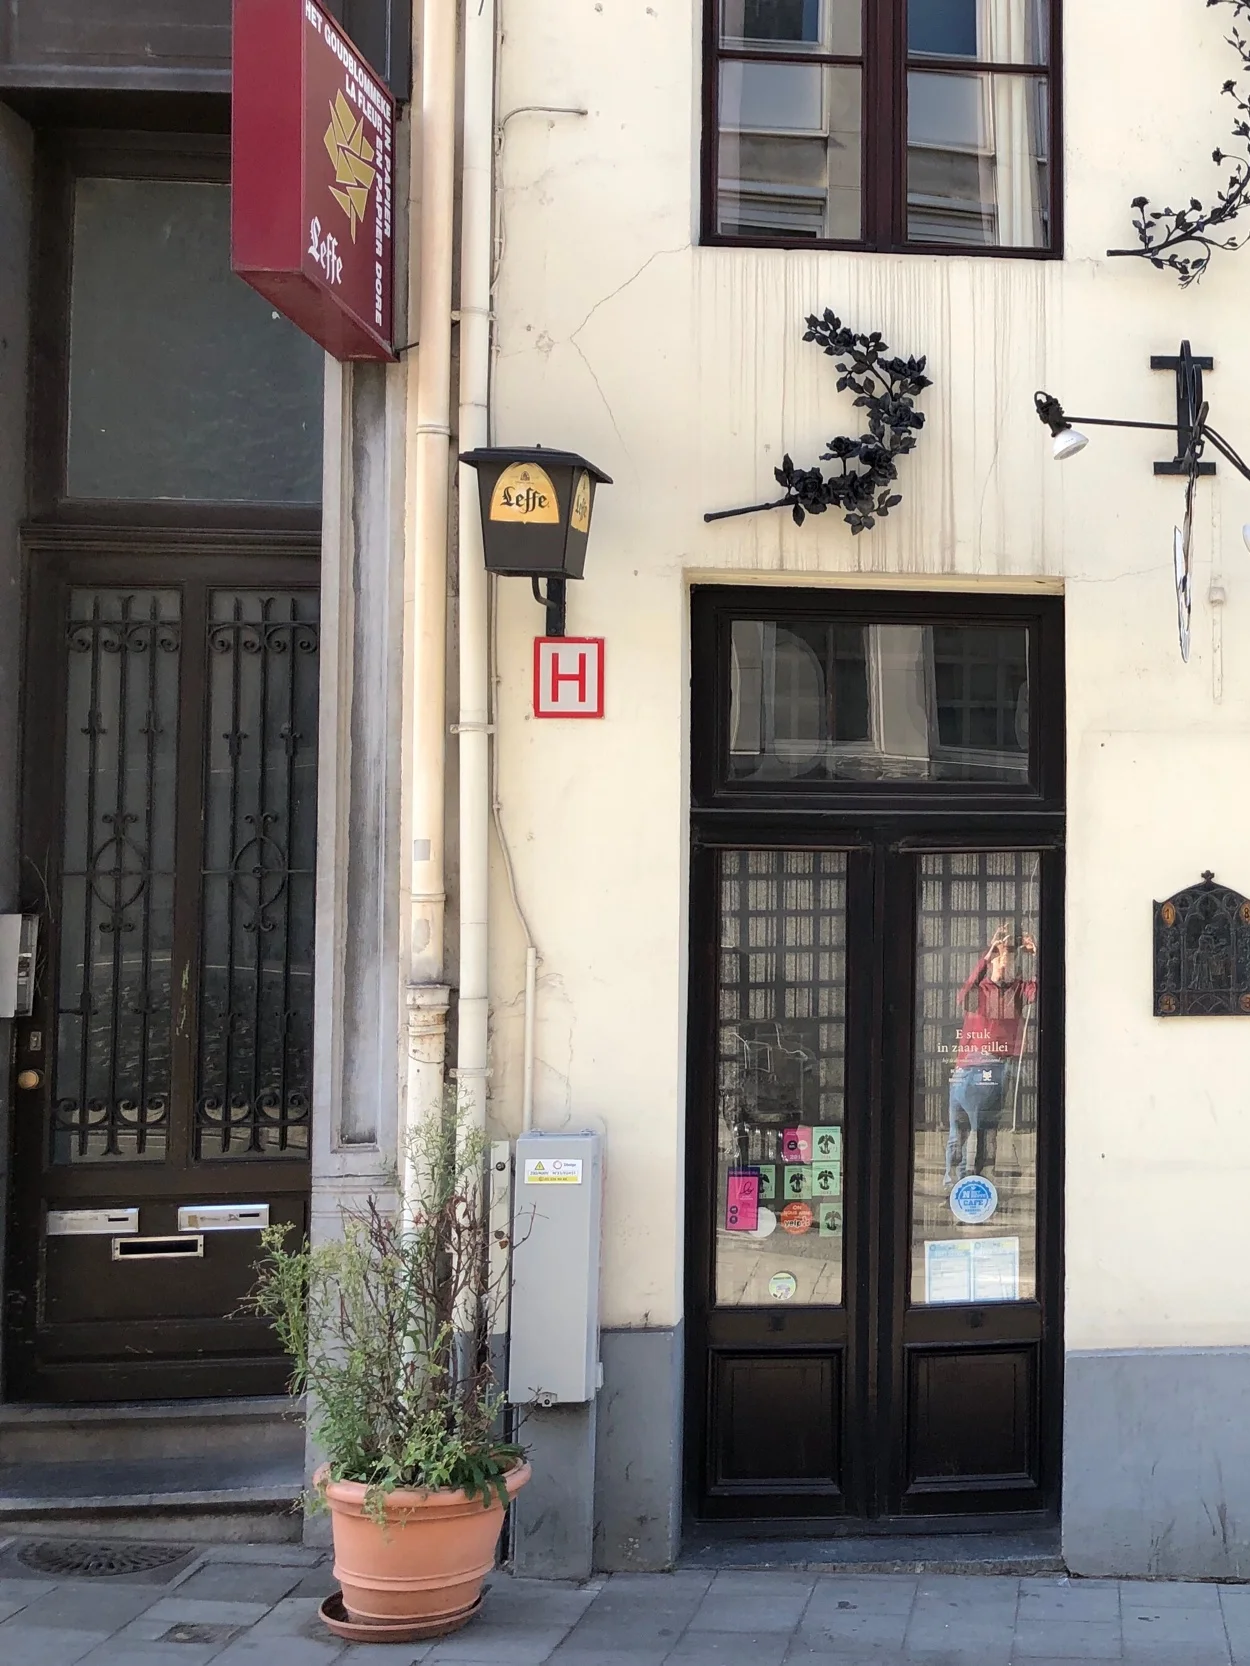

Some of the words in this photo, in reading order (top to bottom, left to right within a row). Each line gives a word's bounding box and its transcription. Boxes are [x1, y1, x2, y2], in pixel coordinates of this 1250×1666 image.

[305, 0, 323, 34] HET
[324, 23, 391, 123] GOUDBLOMMEKE
[345, 73, 357, 103] LA
[357, 89, 383, 135] FLEUR
[375, 135, 383, 170] EN
[375, 172, 383, 257] PAPIER
[308, 216, 343, 285] Leffe
[500, 487, 549, 514] Leffe
[551, 653, 586, 703] H
[937, 1042, 949, 1053] in
[980, 1042, 1009, 1055] gillei
[956, 1029, 963, 1039] E
[966, 1028, 991, 1039] stuk
[784, 1219, 803, 1228] yelp
